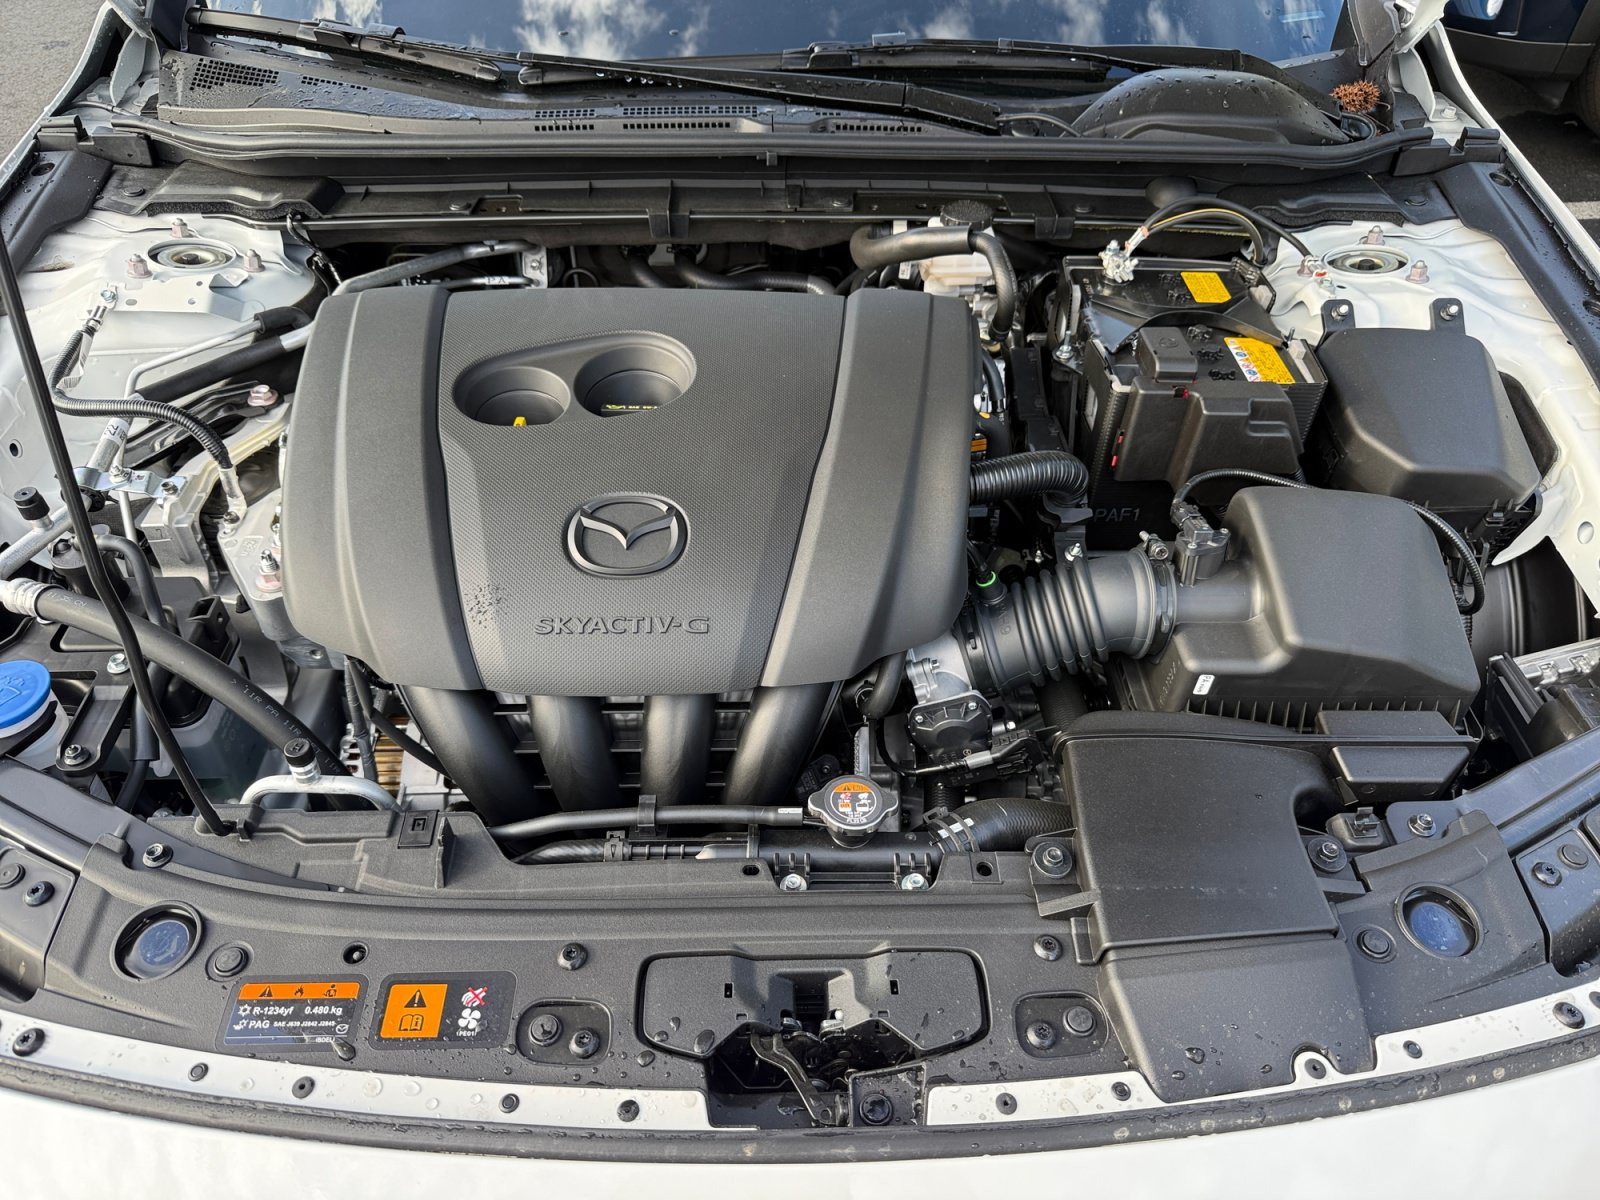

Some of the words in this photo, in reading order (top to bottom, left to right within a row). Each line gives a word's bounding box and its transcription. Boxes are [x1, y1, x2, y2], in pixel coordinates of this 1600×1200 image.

[1093, 507, 1141, 522] PAF1
[534, 616, 710, 635] SKYACTIV-G
[252, 1006, 294, 1017] R-1234yf
[304, 1006, 328, 1015] 0.480
[329, 1006, 343, 1016] kg
[248, 1020, 270, 1029] PAG
